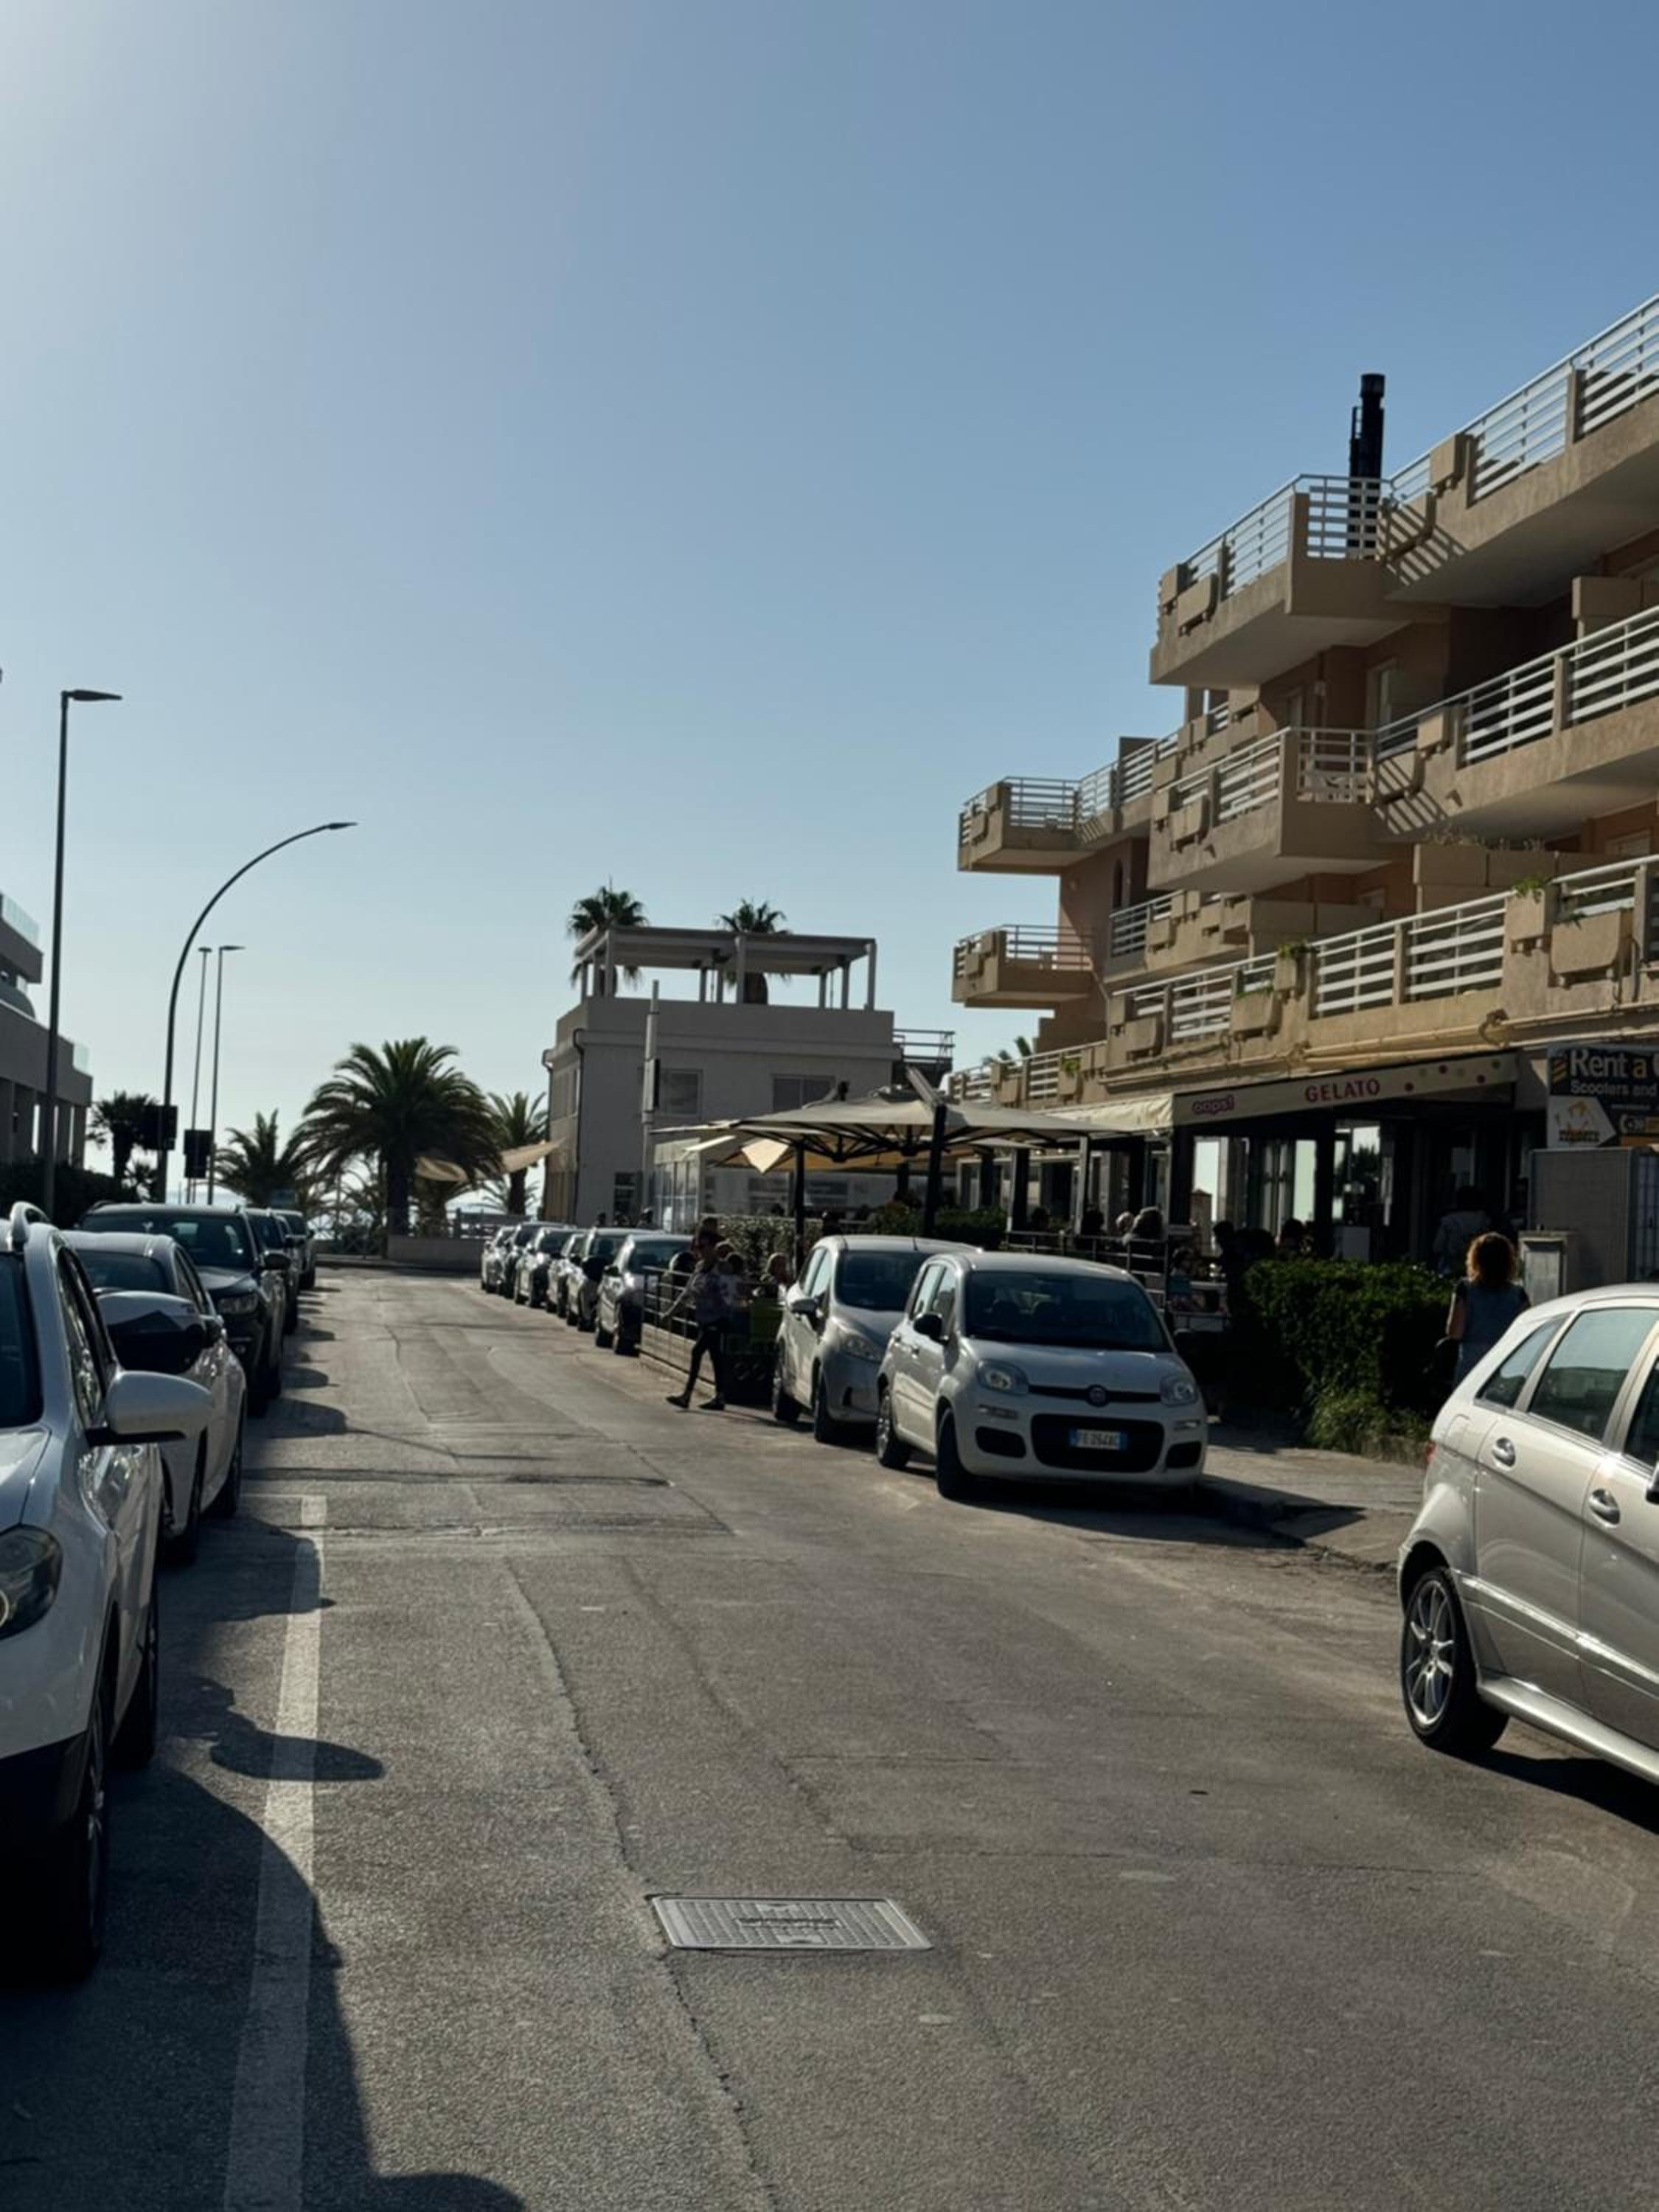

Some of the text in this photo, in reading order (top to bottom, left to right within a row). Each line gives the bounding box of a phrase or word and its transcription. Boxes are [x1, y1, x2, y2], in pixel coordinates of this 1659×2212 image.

[1571, 1050, 1627, 1077] Rent
[1632, 1058, 1647, 1079] a
[1305, 1078, 1380, 1102] GELATO
[1571, 1079, 1658, 1097] Scooters and
